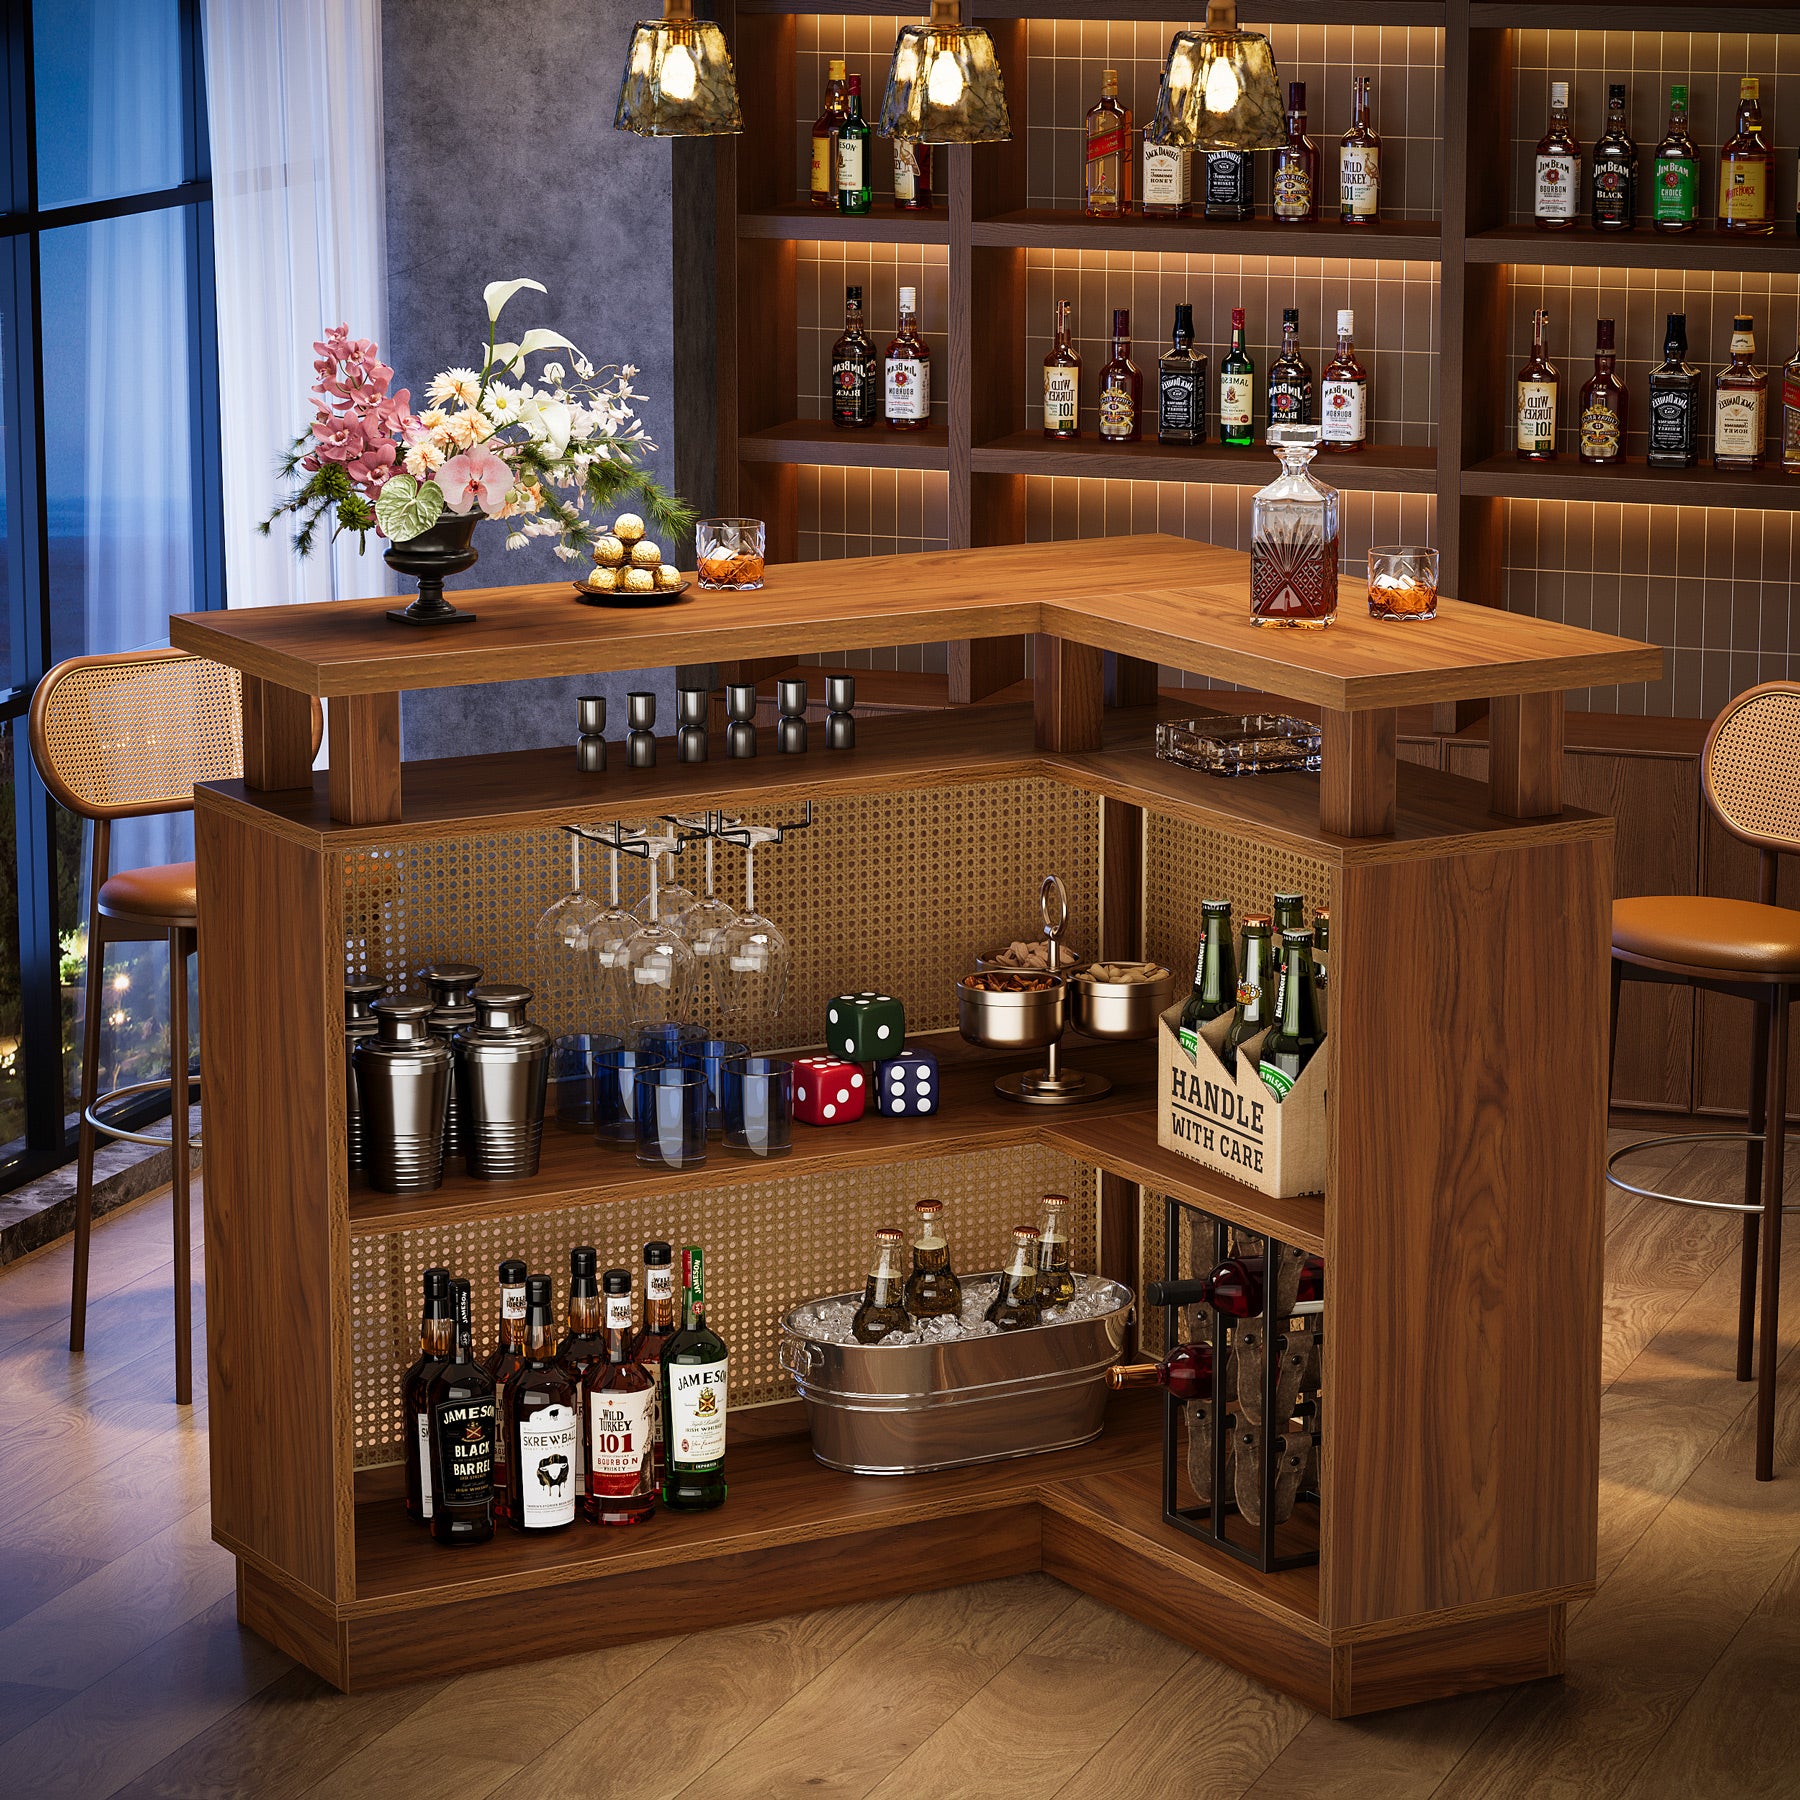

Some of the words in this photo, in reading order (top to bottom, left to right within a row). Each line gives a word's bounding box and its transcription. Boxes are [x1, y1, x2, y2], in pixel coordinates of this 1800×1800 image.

[1145, 149, 1158, 160] JACK
[1158, 146, 1178, 161] DANIEL'S
[1208, 152, 1220, 163] JACK
[1343, 160, 1362, 172] WILD
[1538, 161, 1549, 173] JIM
[1551, 159, 1569, 173] BEAM
[1593, 163, 1606, 178] JIM
[1607, 161, 1629, 178] BEAM
[1656, 165, 1669, 176] JIM
[1669, 162, 1688, 177] BEAM
[1342, 171, 1367, 184] TURKEY
[1342, 186, 1353, 200] 101
[1540, 185, 1566, 193] BOURBON
[1597, 190, 1623, 198] BLACK
[1195, 943, 1205, 985] Heineken
[1275, 973, 1286, 1018] Heineken
[1172, 1066, 1264, 1135] HANDLE
[1171, 1112, 1214, 1152] WITH
[1220, 1134, 1263, 1174] CARE
[693, 1260, 702, 1294] JAMESON
[602, 1409, 624, 1421] WILD
[599, 1417, 632, 1432] TURKEY
[454, 1440, 490, 1458] BLACK
[599, 1433, 635, 1454] 101
[453, 1459, 491, 1476] BARREL
[597, 1457, 638, 1466] BOURBON
